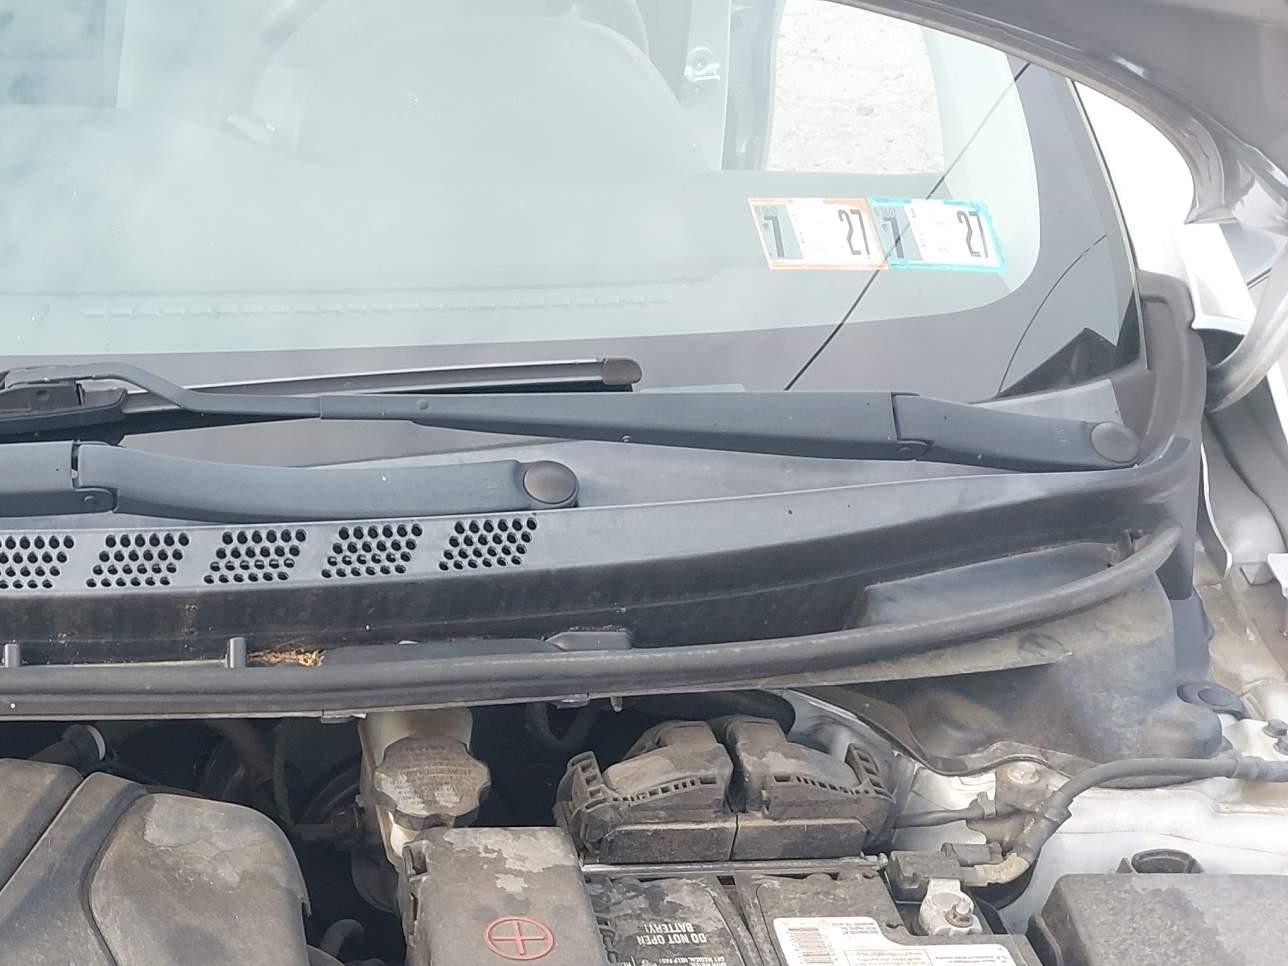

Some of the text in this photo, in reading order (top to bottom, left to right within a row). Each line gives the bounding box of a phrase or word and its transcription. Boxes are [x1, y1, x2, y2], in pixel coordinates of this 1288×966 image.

[838, 208, 872, 259] 27
[956, 209, 990, 258] 27
[636, 933, 707, 945] DO NOT OPEN
[645, 922, 694, 934] BATTERY!
